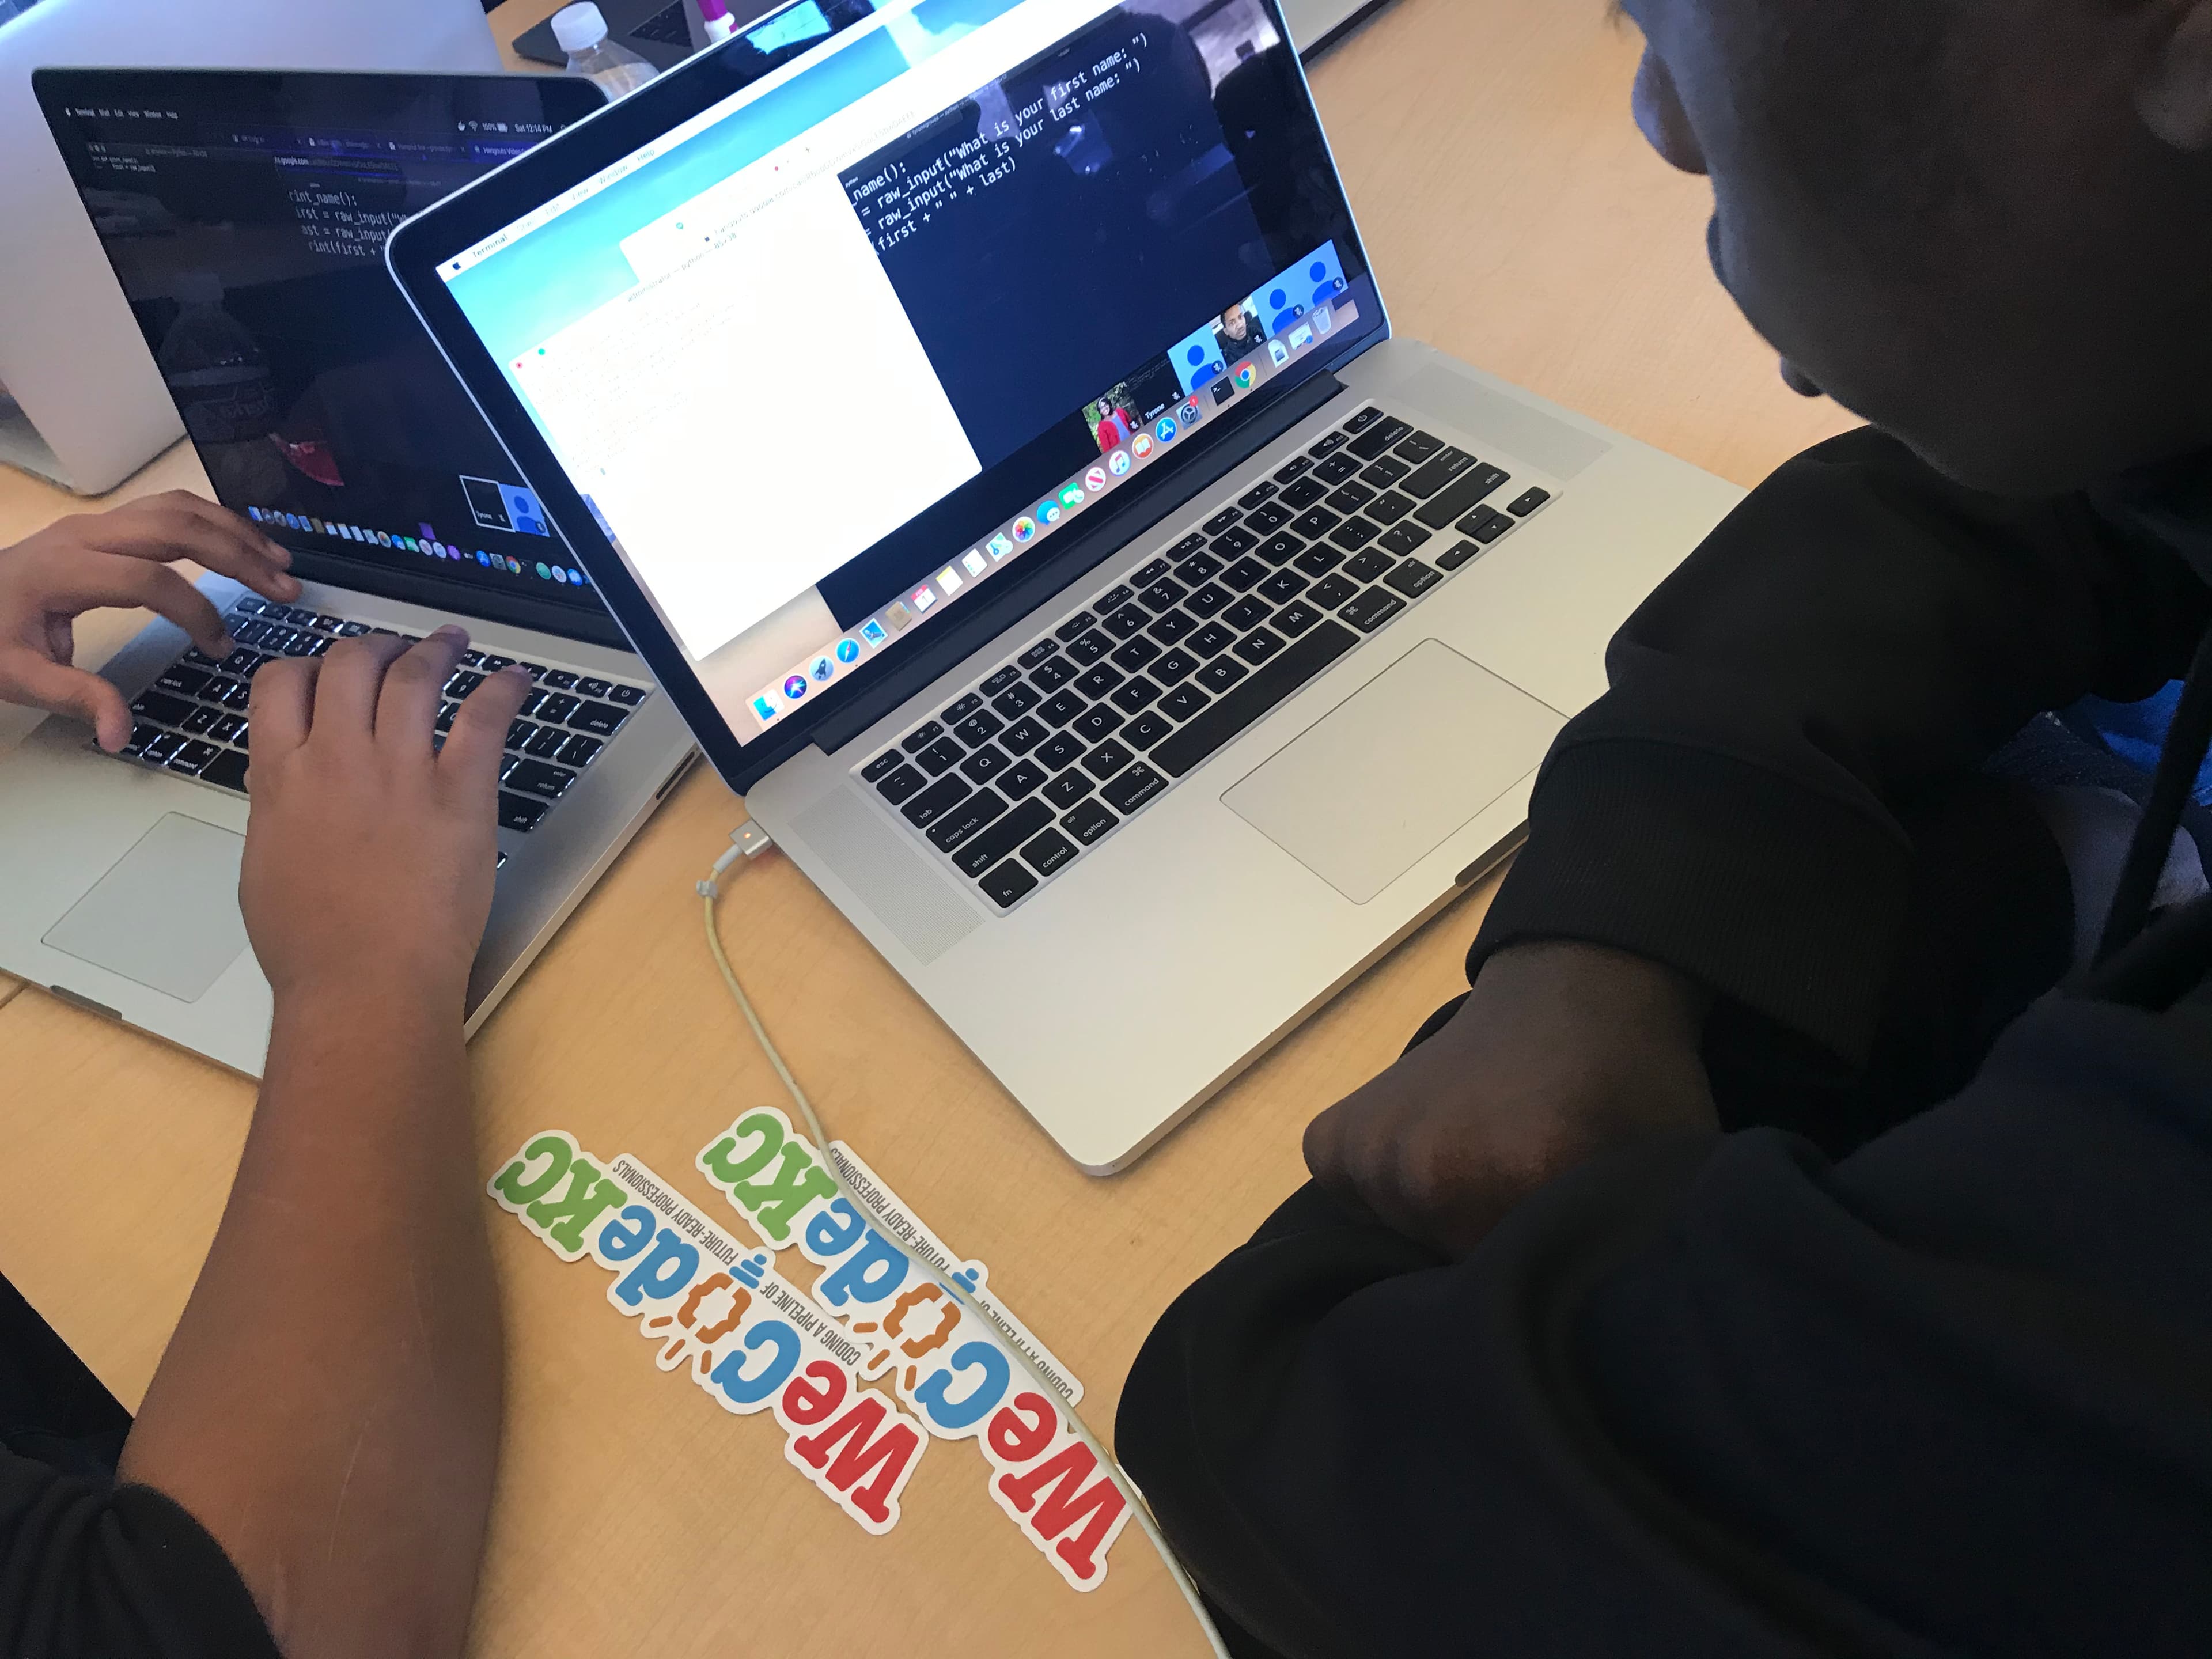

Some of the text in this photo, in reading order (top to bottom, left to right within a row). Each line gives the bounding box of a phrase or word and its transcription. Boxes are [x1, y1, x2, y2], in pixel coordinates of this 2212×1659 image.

[995, 117, 1009, 134] is
[1015, 97, 1044, 126] your
[1051, 73, 1086, 101] first
[1092, 50, 1127, 75] name:
[996, 138, 1010, 157] is
[1015, 119, 1044, 147] your
[1050, 97, 1081, 121] last
[1086, 73, 1121, 101] name:
[922, 213, 931, 222] +
[966, 187, 974, 195] +
[979, 157, 1016, 187] last)
[1144, 403, 1165, 419] Tyrone
[1448, 457, 1470, 474] return
[1309, 517, 1318, 525] P
[1274, 543, 1286, 551] O
[1277, 579, 1289, 589] K
[1414, 571, 1435, 588] option
[1202, 594, 1214, 603] U
[1244, 607, 1252, 615] J
[1365, 600, 1397, 624] command
[1289, 612, 1304, 623] M
[1165, 621, 1176, 629] Y
[1203, 633, 1217, 643] H
[1089, 645, 1099, 653] 5
[1252, 639, 1266, 649] N
[1130, 647, 1139, 656] T
[1168, 661, 1179, 669] G
[1215, 668, 1226, 677] B
[1093, 676, 1104, 684] R
[1130, 689, 1139, 698] F
[1015, 699, 1024, 707] 3
[1176, 695, 1187, 704] V
[1055, 702, 1066, 711] E
[1091, 717, 1103, 726] D
[977, 726, 987, 735] 2
[1139, 724, 1151, 733] C
[1015, 729, 1029, 740] W
[1054, 745, 1065, 754] S
[979, 758, 991, 767] Q
[1101, 752, 1113, 763] X
[876, 758, 888, 768] esc
[1017, 775, 1028, 784] A
[1061, 781, 1074, 792] Z
[1124, 778, 1160, 806] command
[919, 809, 933, 819] tab
[945, 817, 979, 843] caps lock
[1083, 819, 1106, 838] option
[1043, 847, 1067, 868] control
[613, 1160, 738, 1266] FUTURE-READY PROFESSIONALS
[760, 1282, 861, 1366] CODING A PIPELINE OF
